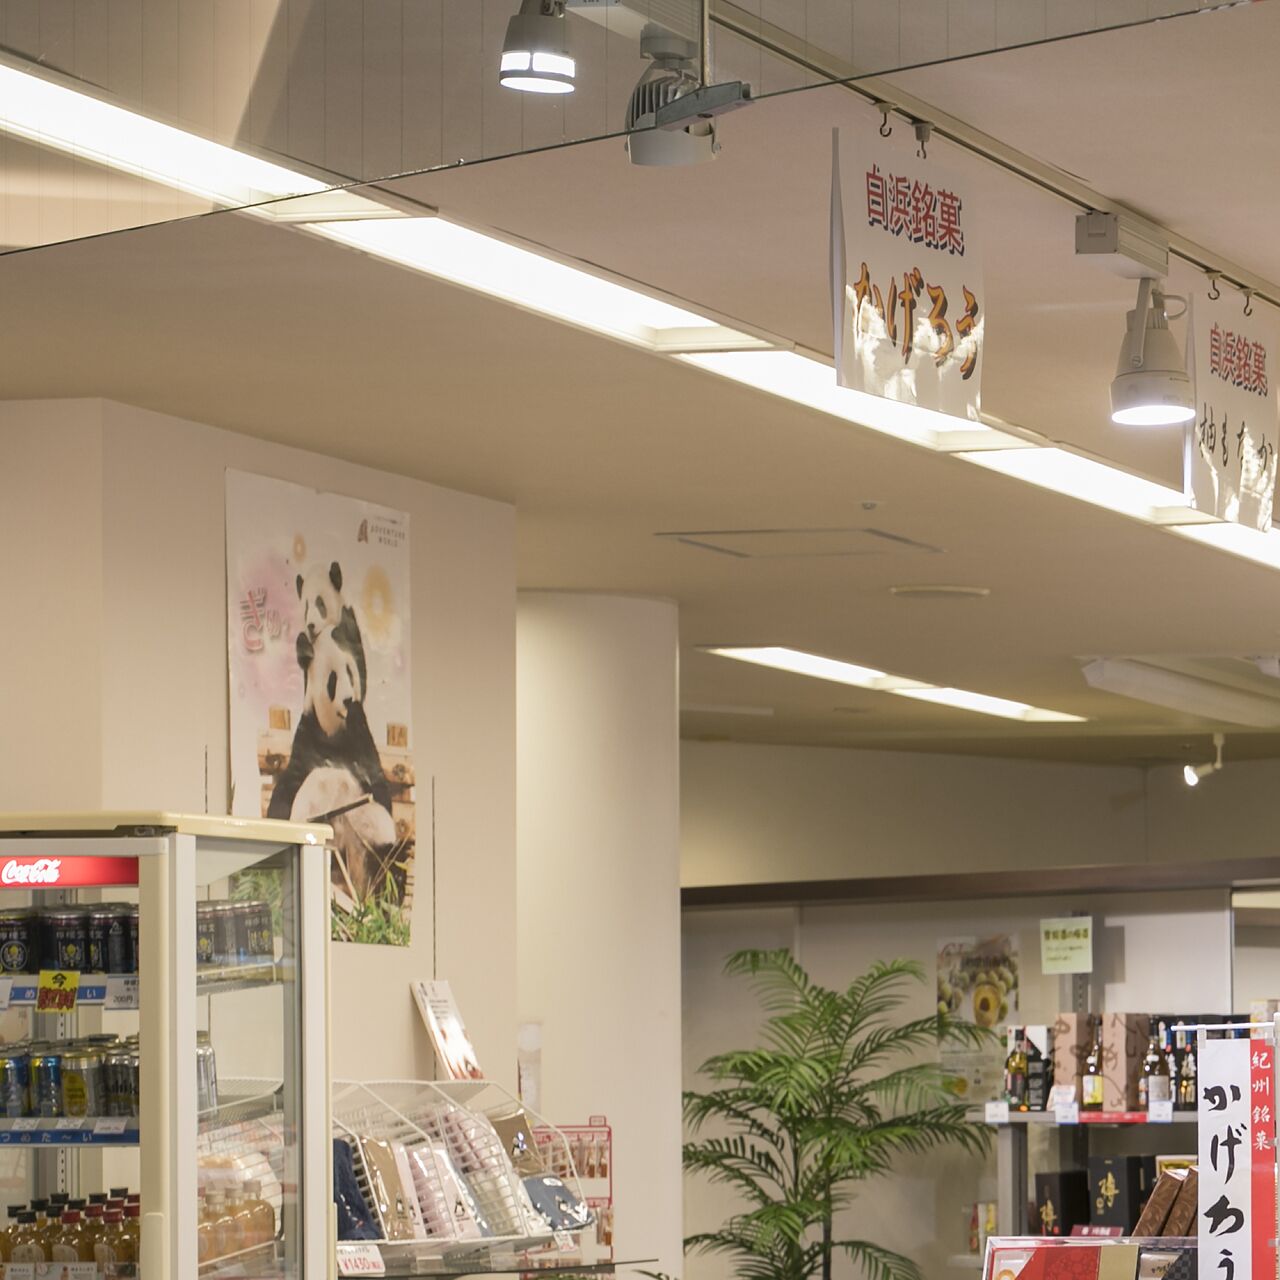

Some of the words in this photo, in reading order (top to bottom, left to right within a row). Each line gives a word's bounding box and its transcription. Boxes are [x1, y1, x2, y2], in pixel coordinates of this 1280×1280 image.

[866, 162, 965, 255] 白浜銘菓
[854, 262, 980, 381] かげろう
[1210, 322, 1268, 395] 白浜銘菓
[1251, 1050, 1271, 1151] 紀州銘菓
